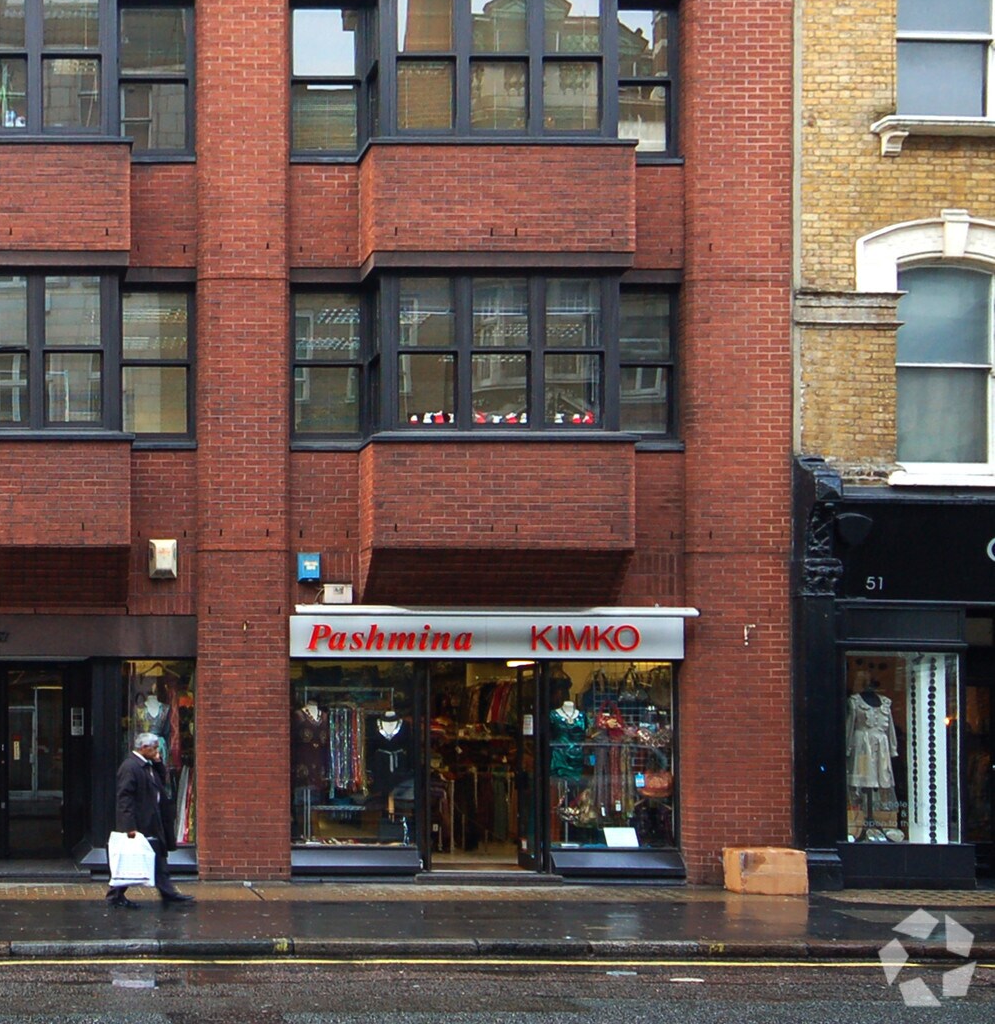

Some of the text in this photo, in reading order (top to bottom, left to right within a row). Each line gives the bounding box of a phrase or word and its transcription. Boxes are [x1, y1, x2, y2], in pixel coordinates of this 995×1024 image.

[865, 576, 884, 591] 51
[306, 624, 641, 652] Pashmina KIMKO
